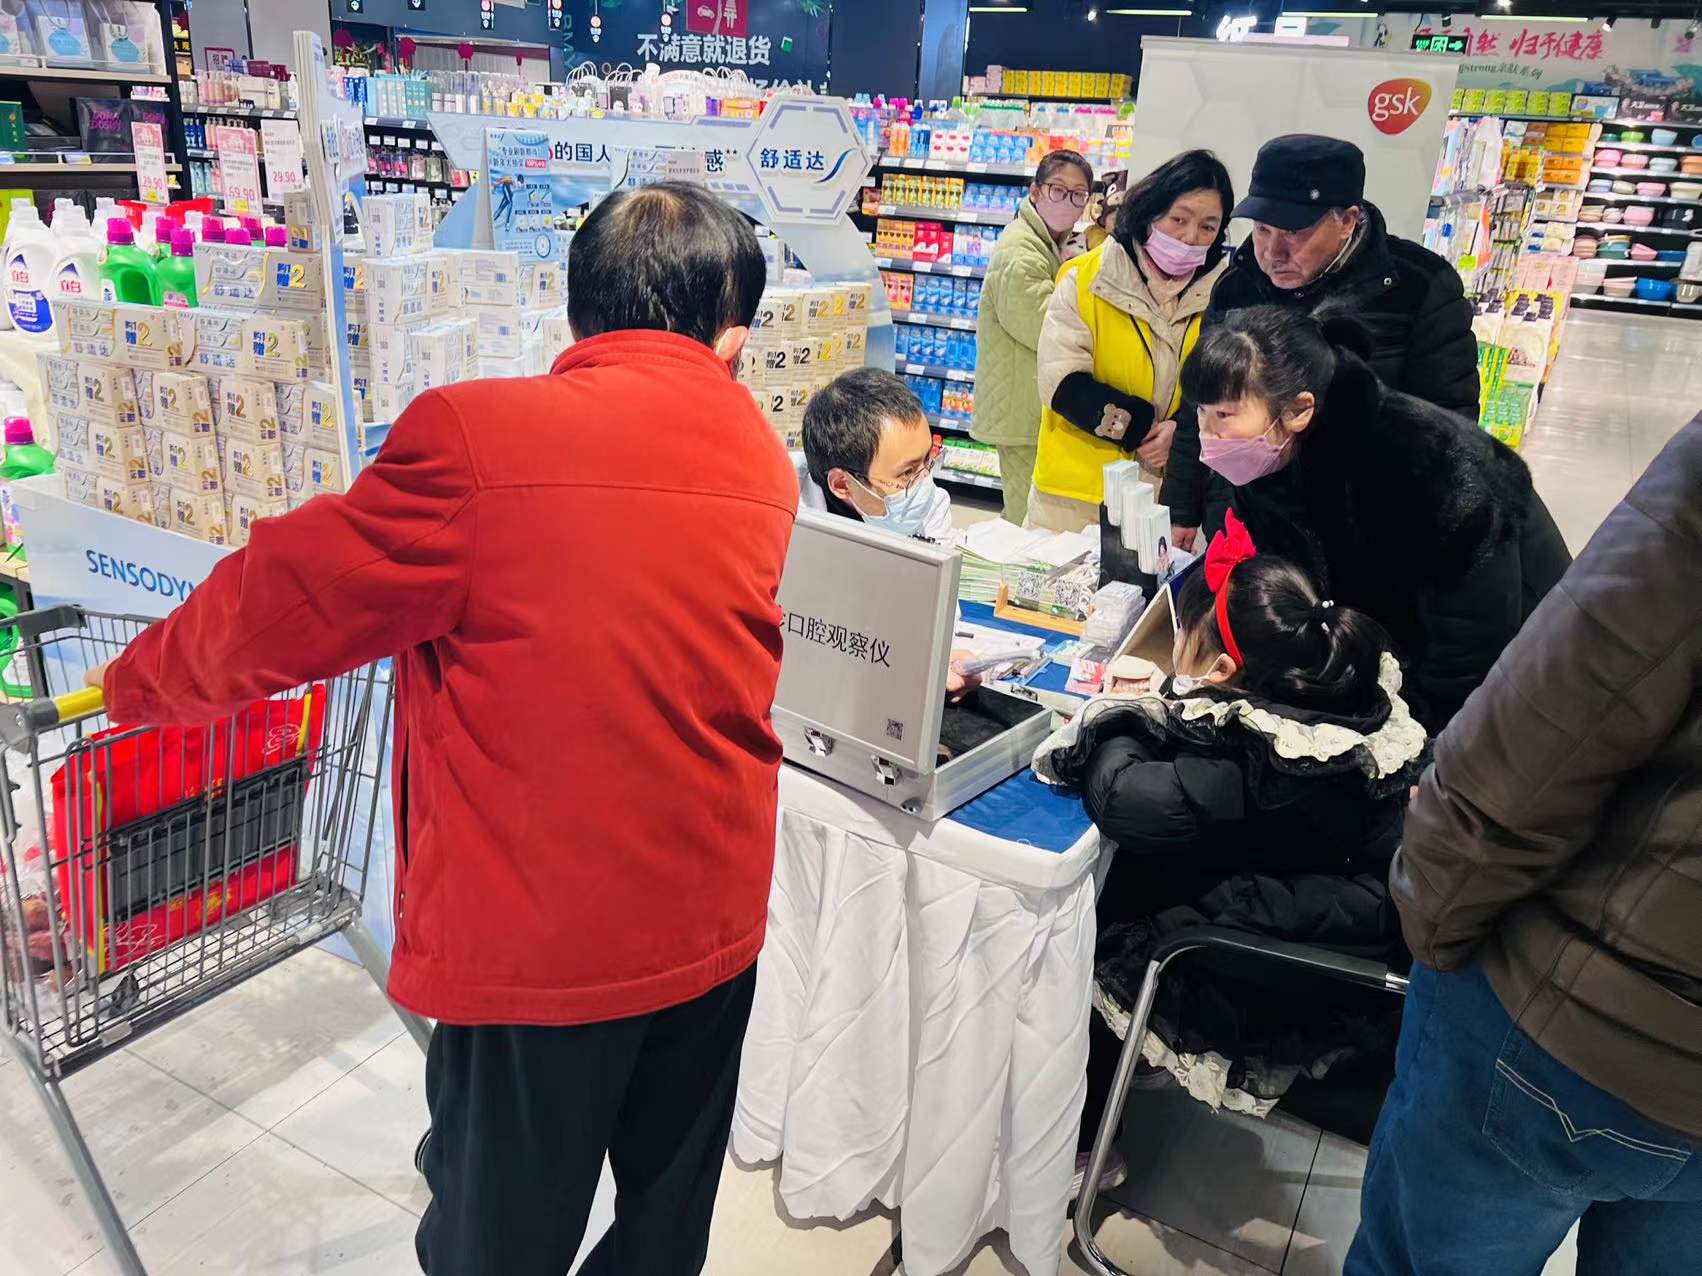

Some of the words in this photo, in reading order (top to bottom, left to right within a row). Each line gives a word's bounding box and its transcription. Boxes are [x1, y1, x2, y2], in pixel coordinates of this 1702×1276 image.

[636, 33, 772, 66] 不满意就退货
[1371, 88, 1423, 121] gsk
[554, 142, 610, 162] 的国人
[760, 149, 825, 171] 舒适达
[142, 175, 163, 190] 29.90
[272, 171, 296, 182] 29.90
[290, 264, 306, 288] 2
[355, 263, 364, 289] 2
[760, 310, 774, 328] 2
[784, 304, 796, 322] 2
[138, 320, 152, 346] 2
[266, 332, 280, 358] 2
[800, 348, 811, 364] 2
[775, 352, 786, 369] 2
[772, 396, 784, 412] 2
[322, 404, 335, 430] 2
[322, 464, 334, 488] 2
[778, 604, 891, 668] 口腔观察仪
